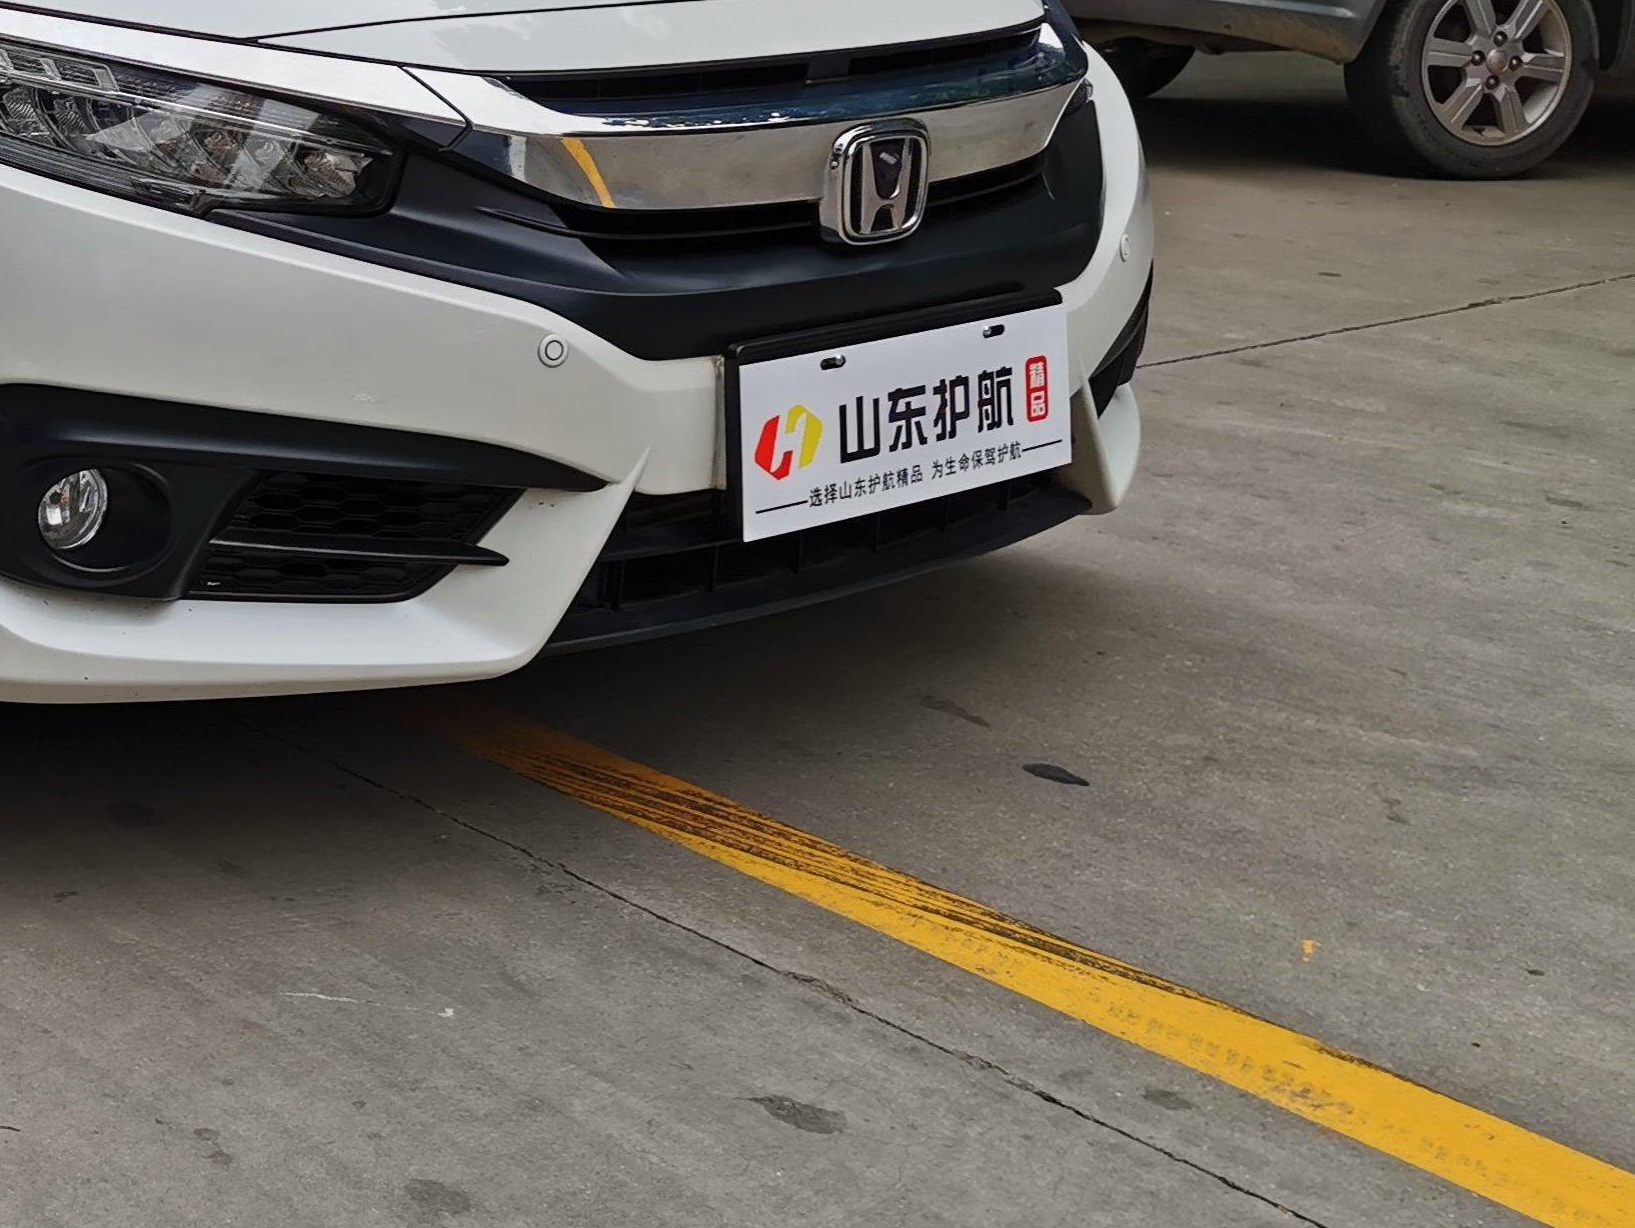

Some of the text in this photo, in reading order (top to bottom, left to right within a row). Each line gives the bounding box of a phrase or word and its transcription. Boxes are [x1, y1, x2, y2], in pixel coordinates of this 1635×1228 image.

[839, 367, 1013, 463] 山东护航
[809, 441, 1022, 507] 选择山东护航精品 为生命保驾护航
